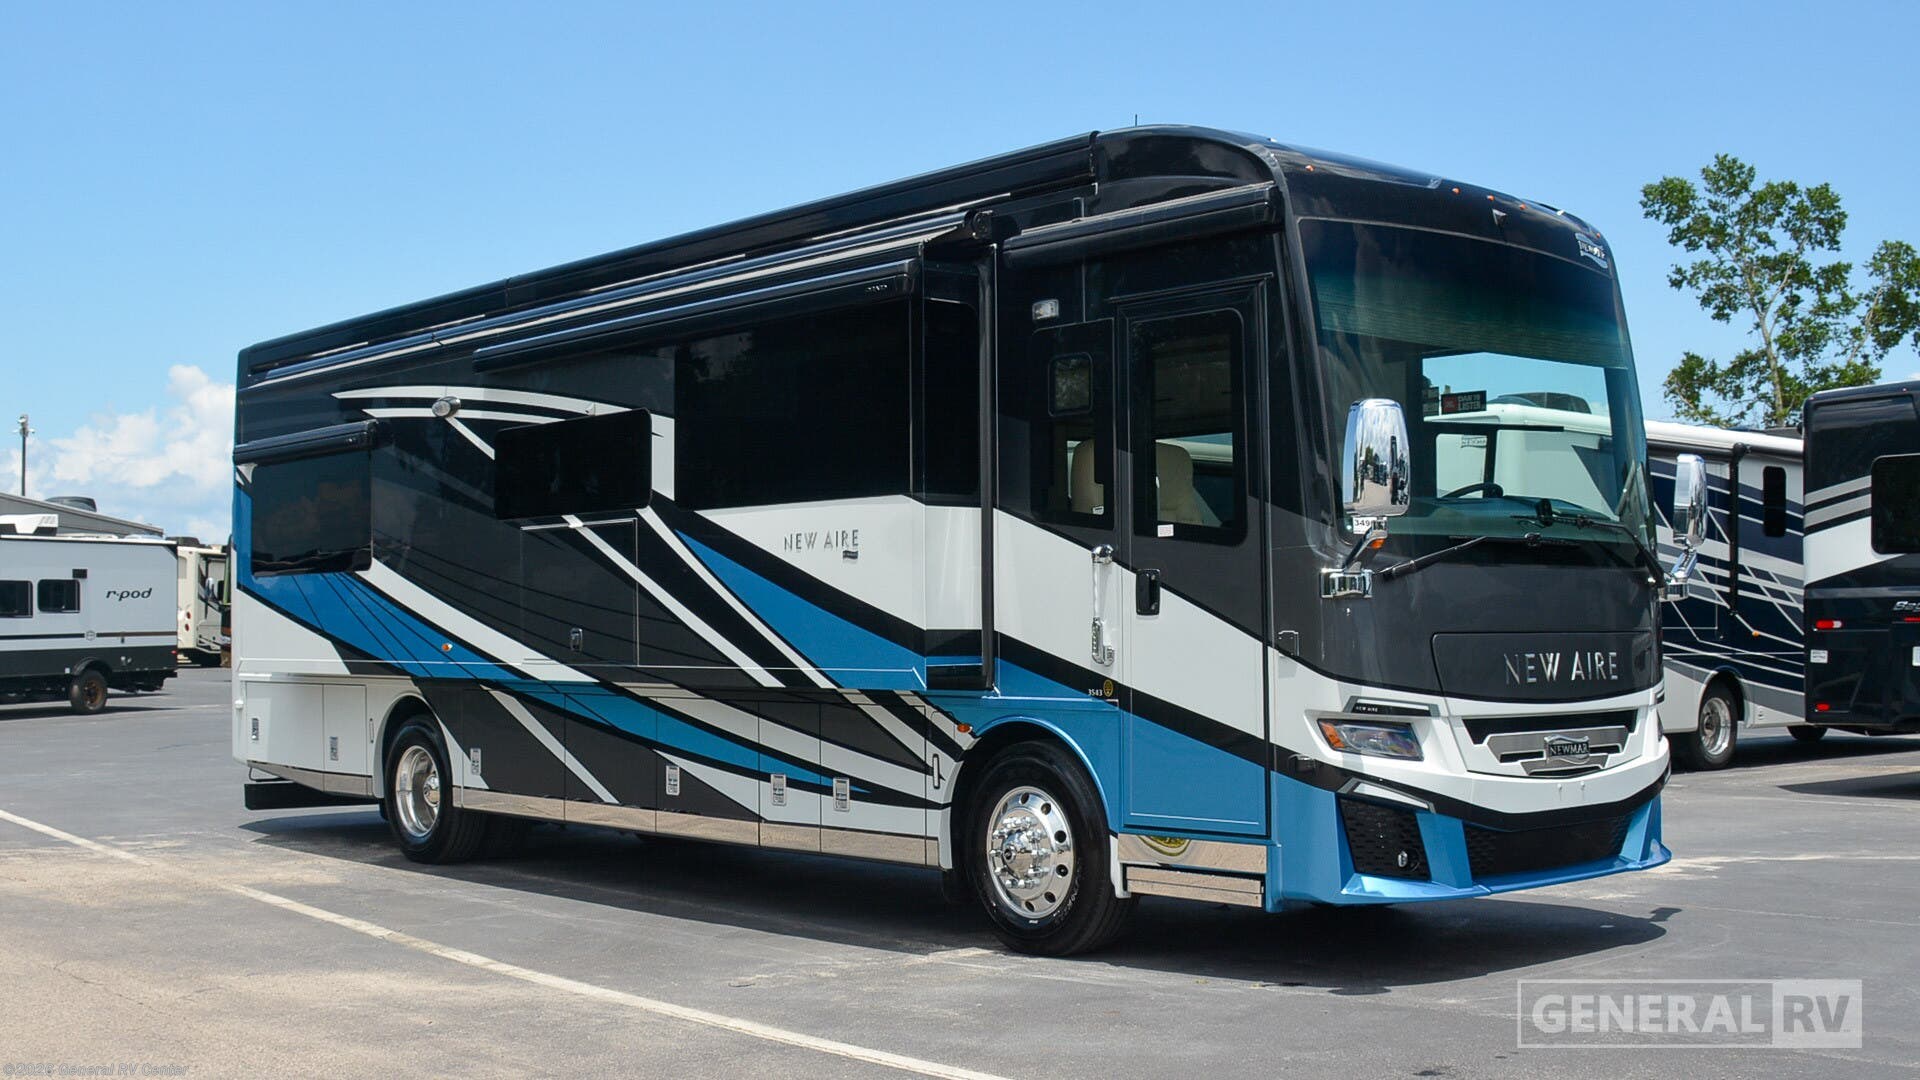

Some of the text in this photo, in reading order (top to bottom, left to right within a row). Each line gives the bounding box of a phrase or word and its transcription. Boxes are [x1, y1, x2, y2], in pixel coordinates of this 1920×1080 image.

[784, 529, 859, 551] NEW AIRE
[1503, 650, 1619, 685] NEW AIRE
[1549, 742, 1589, 756] NEWMAR
